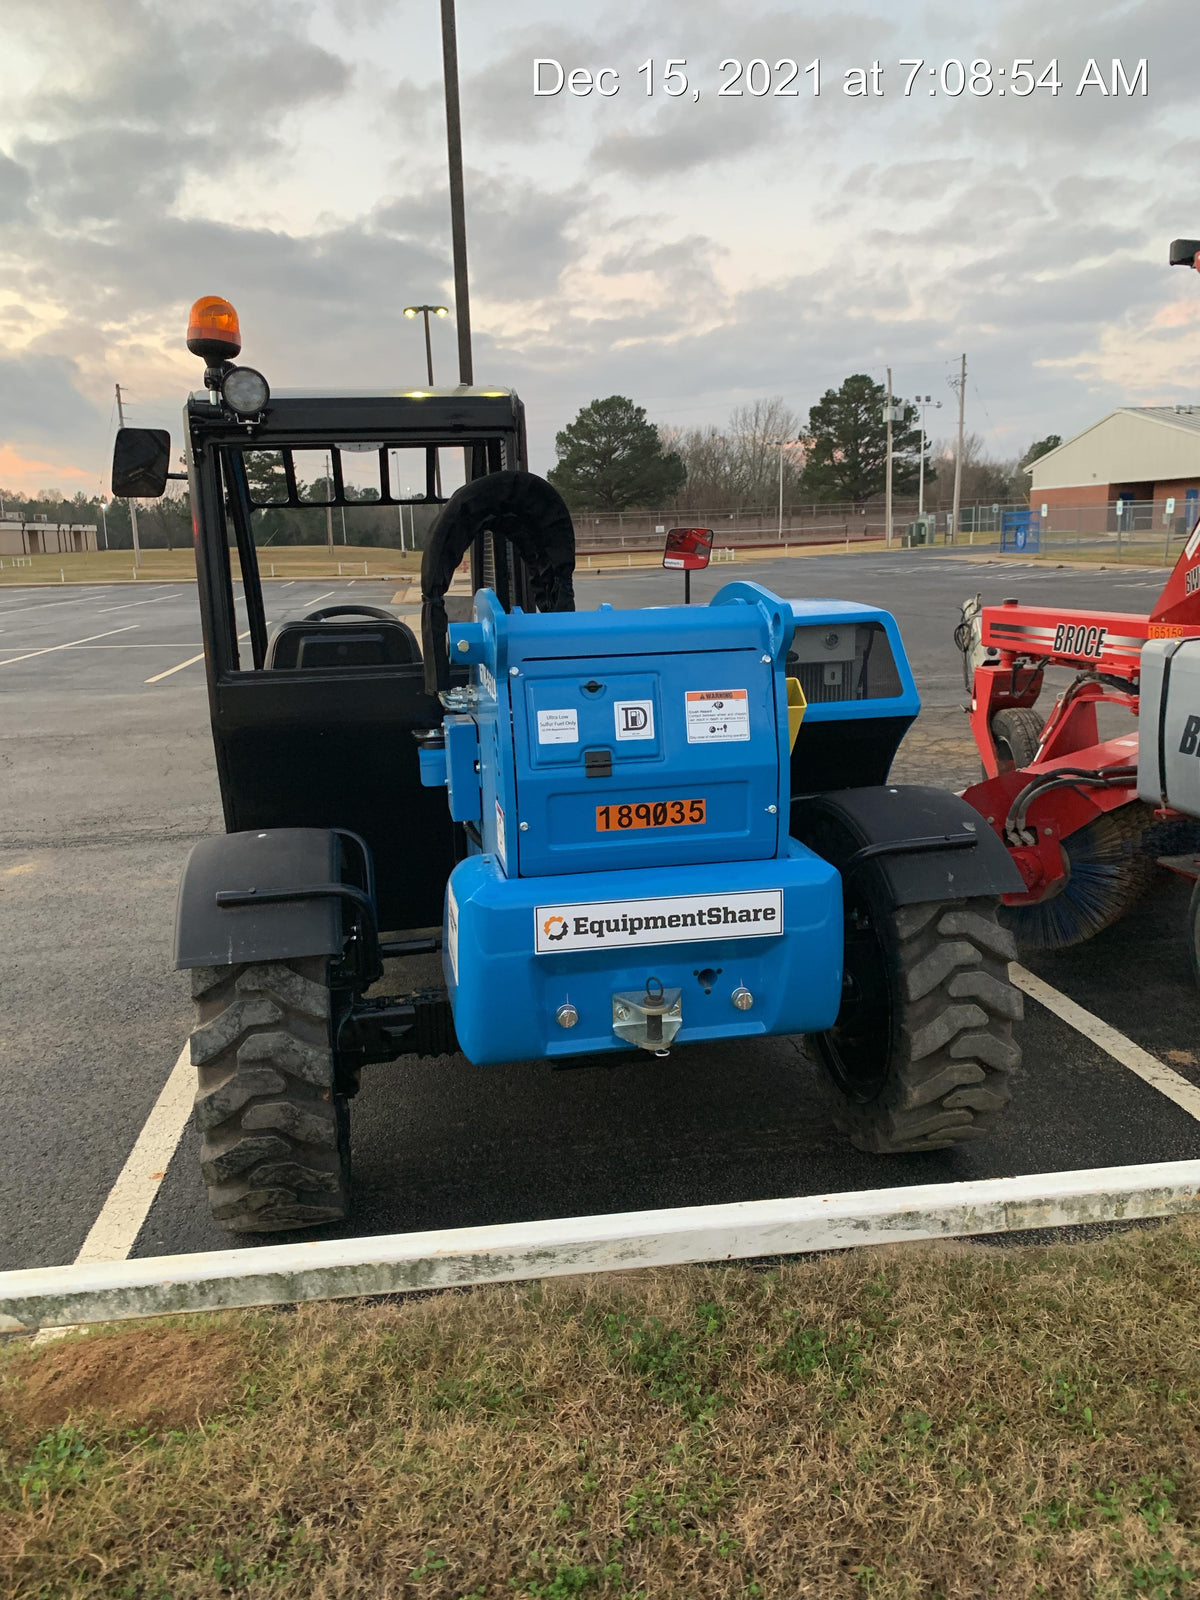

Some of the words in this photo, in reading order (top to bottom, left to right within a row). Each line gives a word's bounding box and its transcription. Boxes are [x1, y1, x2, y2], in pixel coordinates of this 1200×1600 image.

[1053, 623, 1108, 658] BROCE
[1179, 714, 1200, 758] B
[599, 800, 704, 829] 189035
[573, 906, 776, 938] EquipmentShare
